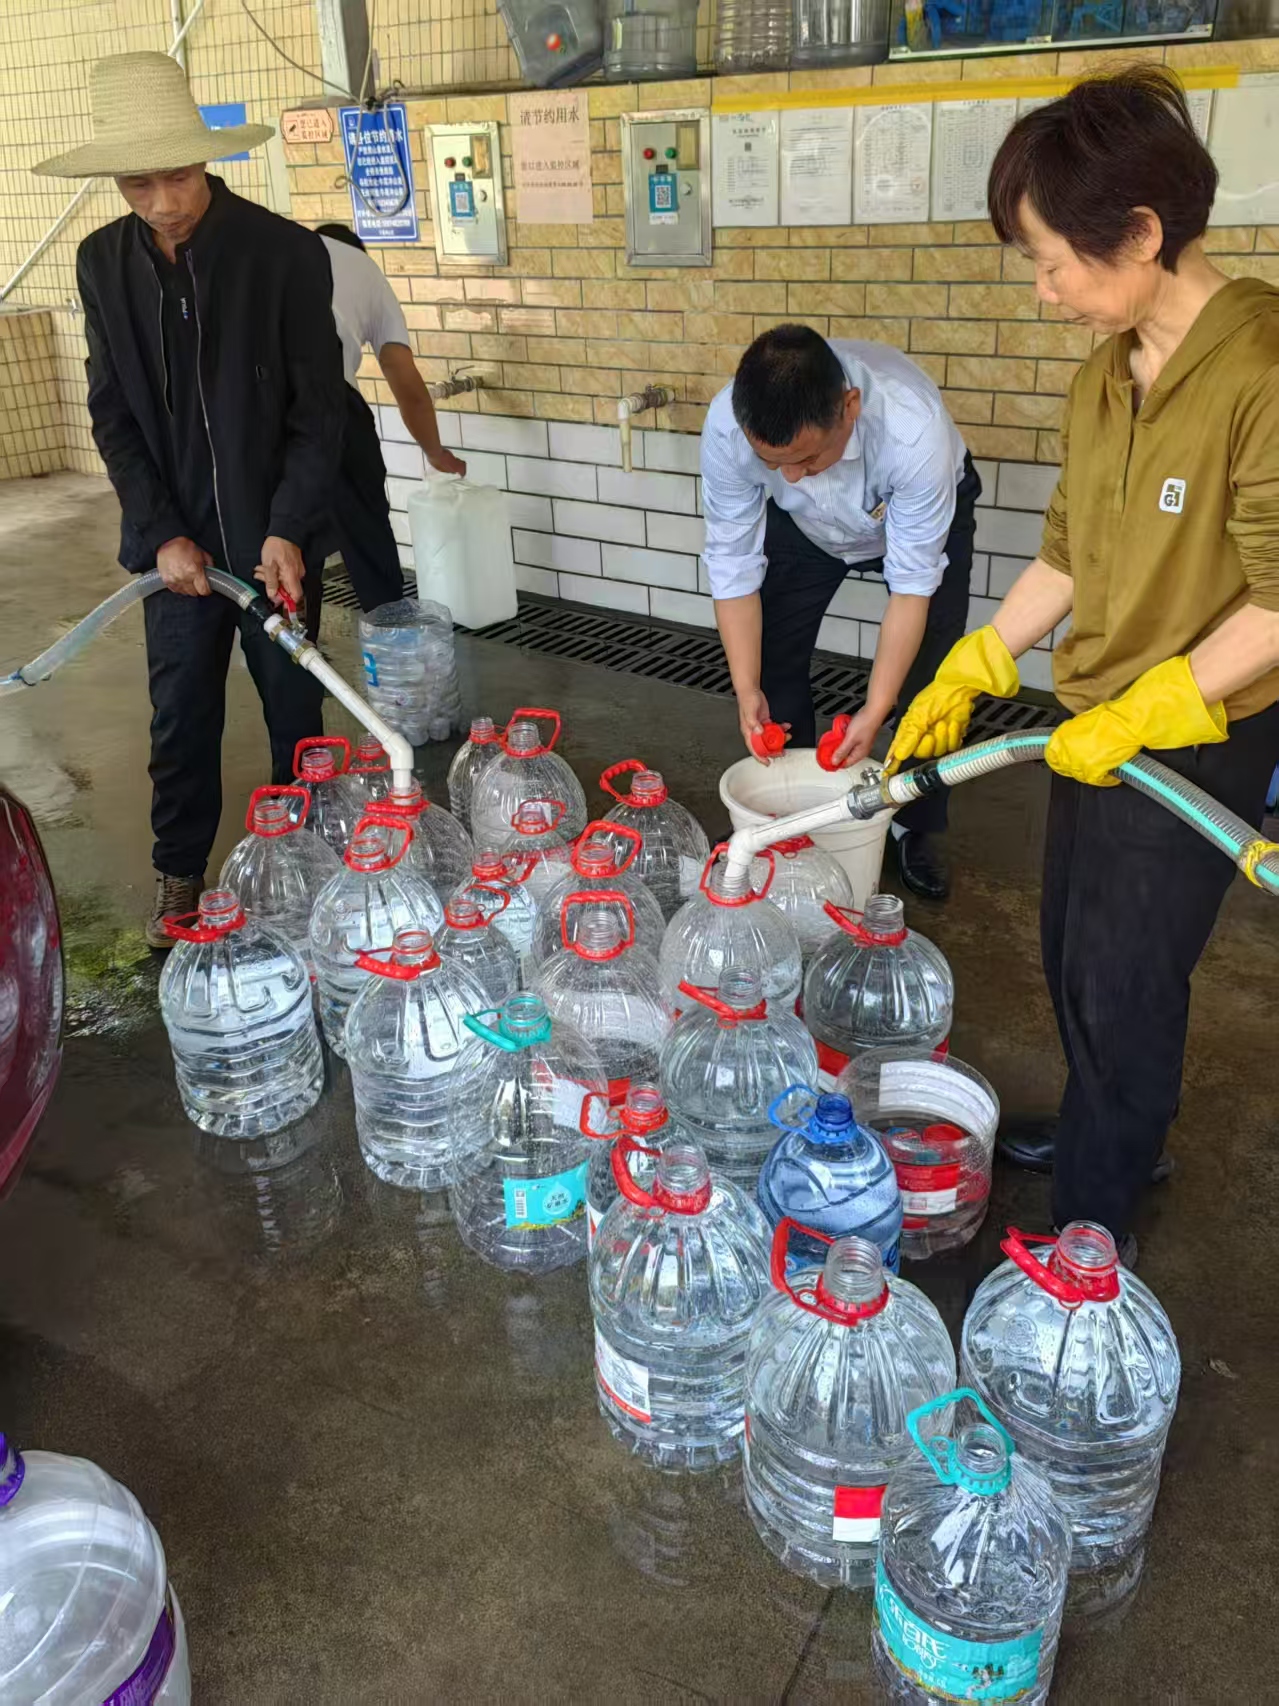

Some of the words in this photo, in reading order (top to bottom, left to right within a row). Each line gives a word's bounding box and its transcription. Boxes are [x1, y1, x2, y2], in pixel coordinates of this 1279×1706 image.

[520, 105, 580, 126] 请节约用水
